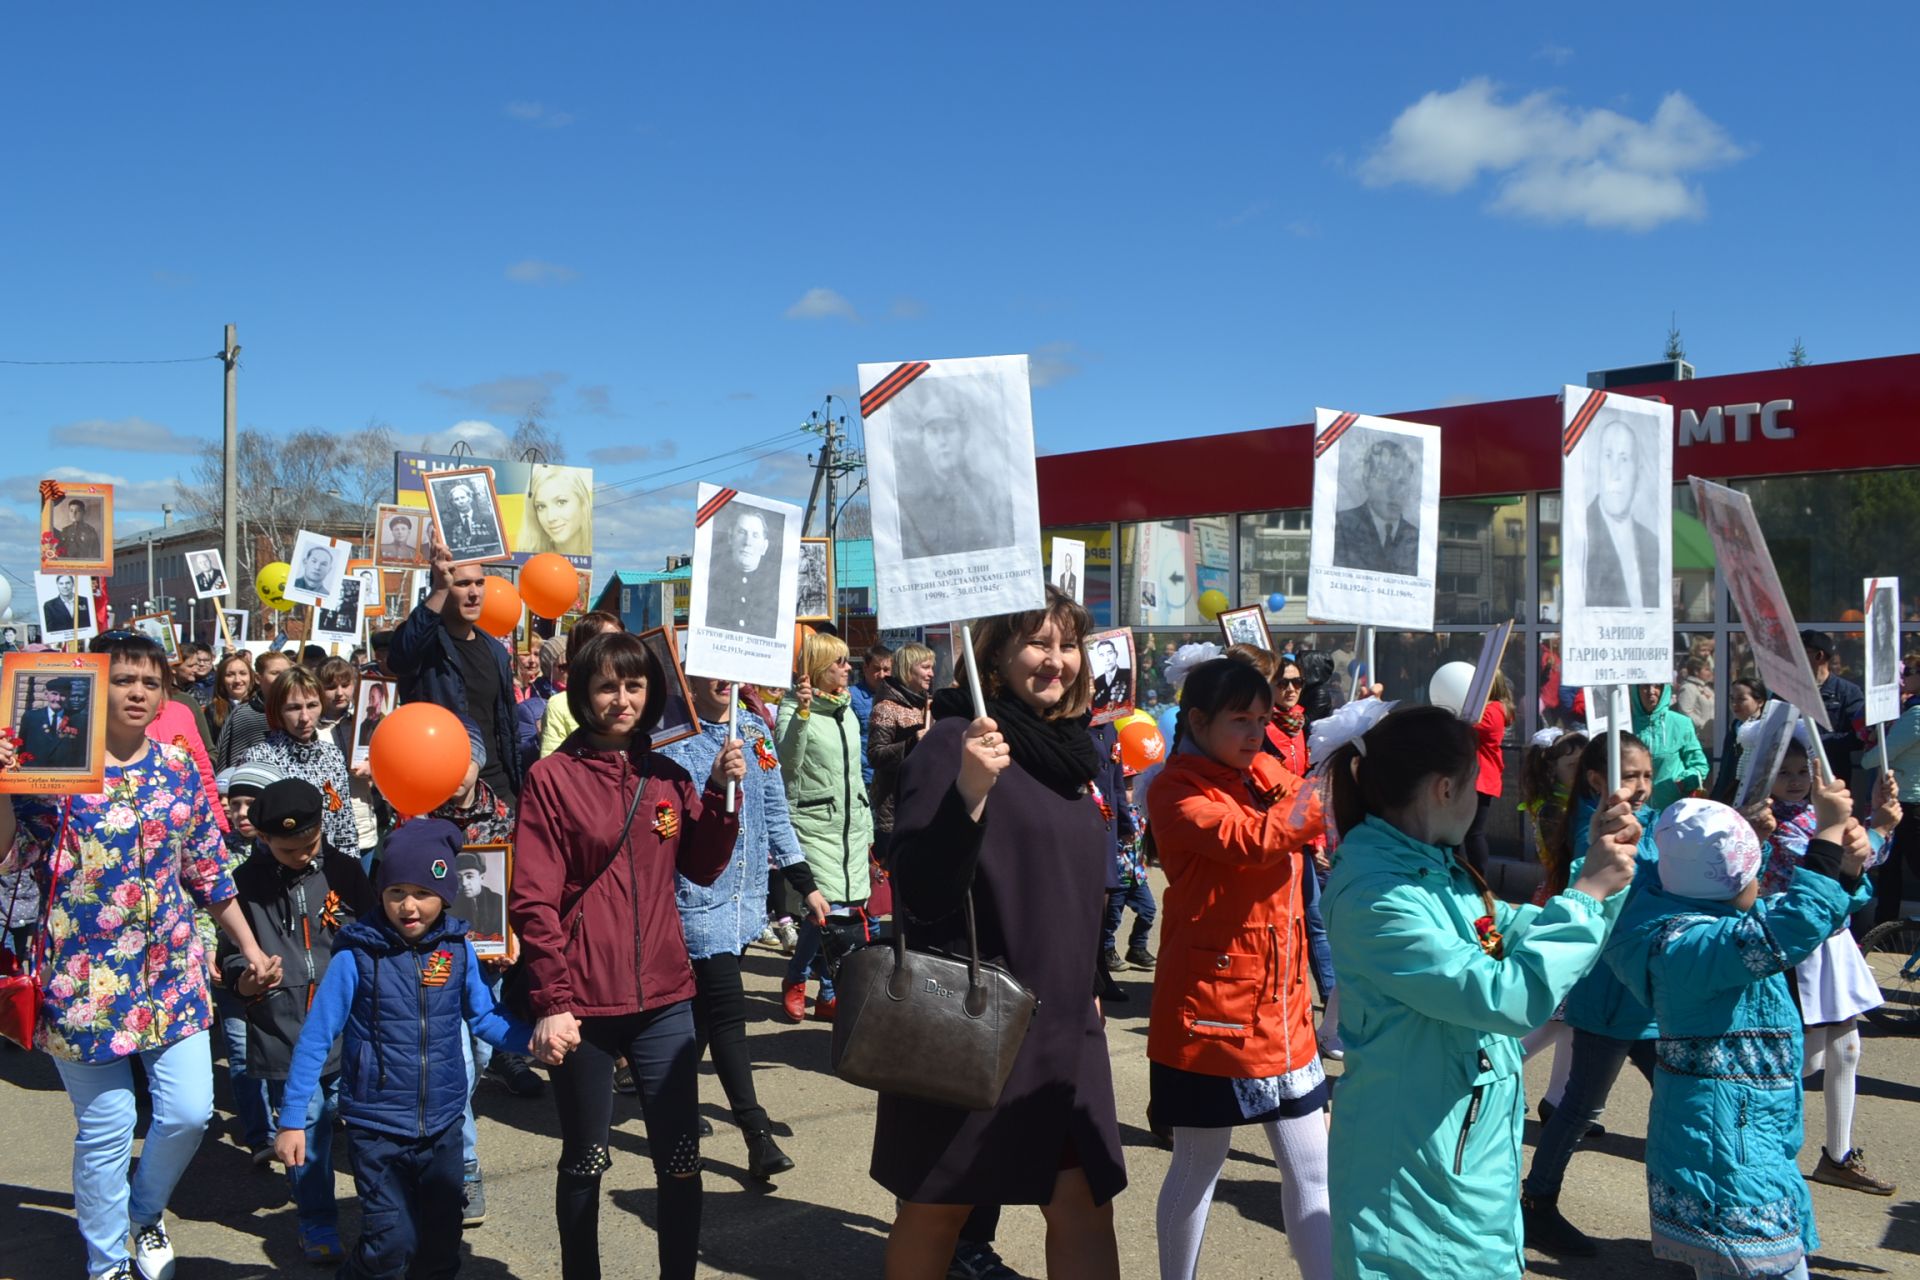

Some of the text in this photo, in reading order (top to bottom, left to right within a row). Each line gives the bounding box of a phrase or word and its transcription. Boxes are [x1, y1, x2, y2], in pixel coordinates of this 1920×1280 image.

[1678, 399, 1794, 446] МТС
[1598, 626, 1646, 640] ЗАРИПОВ
[1569, 647, 1669, 661] ГАРИФ ЗАРИПОВИЧ
[925, 978, 954, 998] Dior
